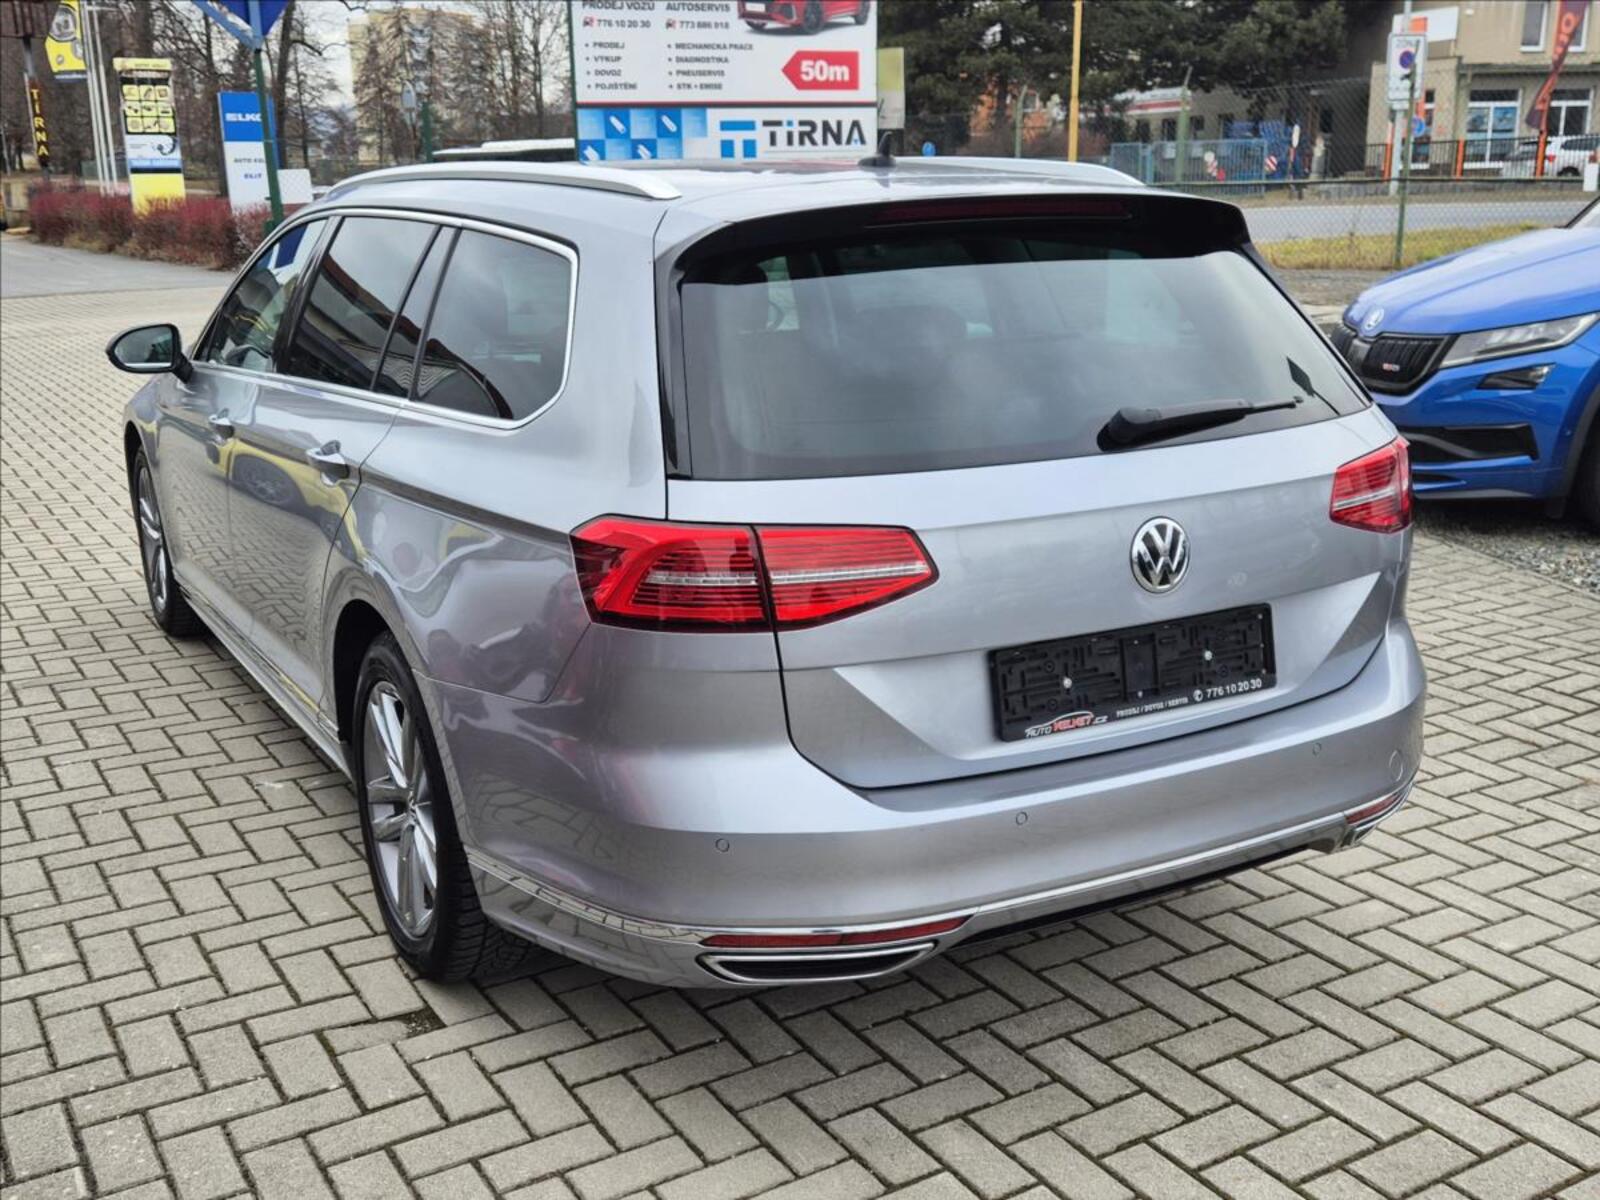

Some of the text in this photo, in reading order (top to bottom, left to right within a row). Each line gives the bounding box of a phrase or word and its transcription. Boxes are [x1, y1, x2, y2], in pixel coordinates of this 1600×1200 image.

[582, 1, 624, 9] PRODEJ
[666, 2, 731, 11] AUTOSERVIS
[597, 19, 612, 27] 776
[801, 60, 849, 82] 50m
[31, 89, 49, 156] TIRNA
[1206, 678, 1262, 698] 776 10 20 30
